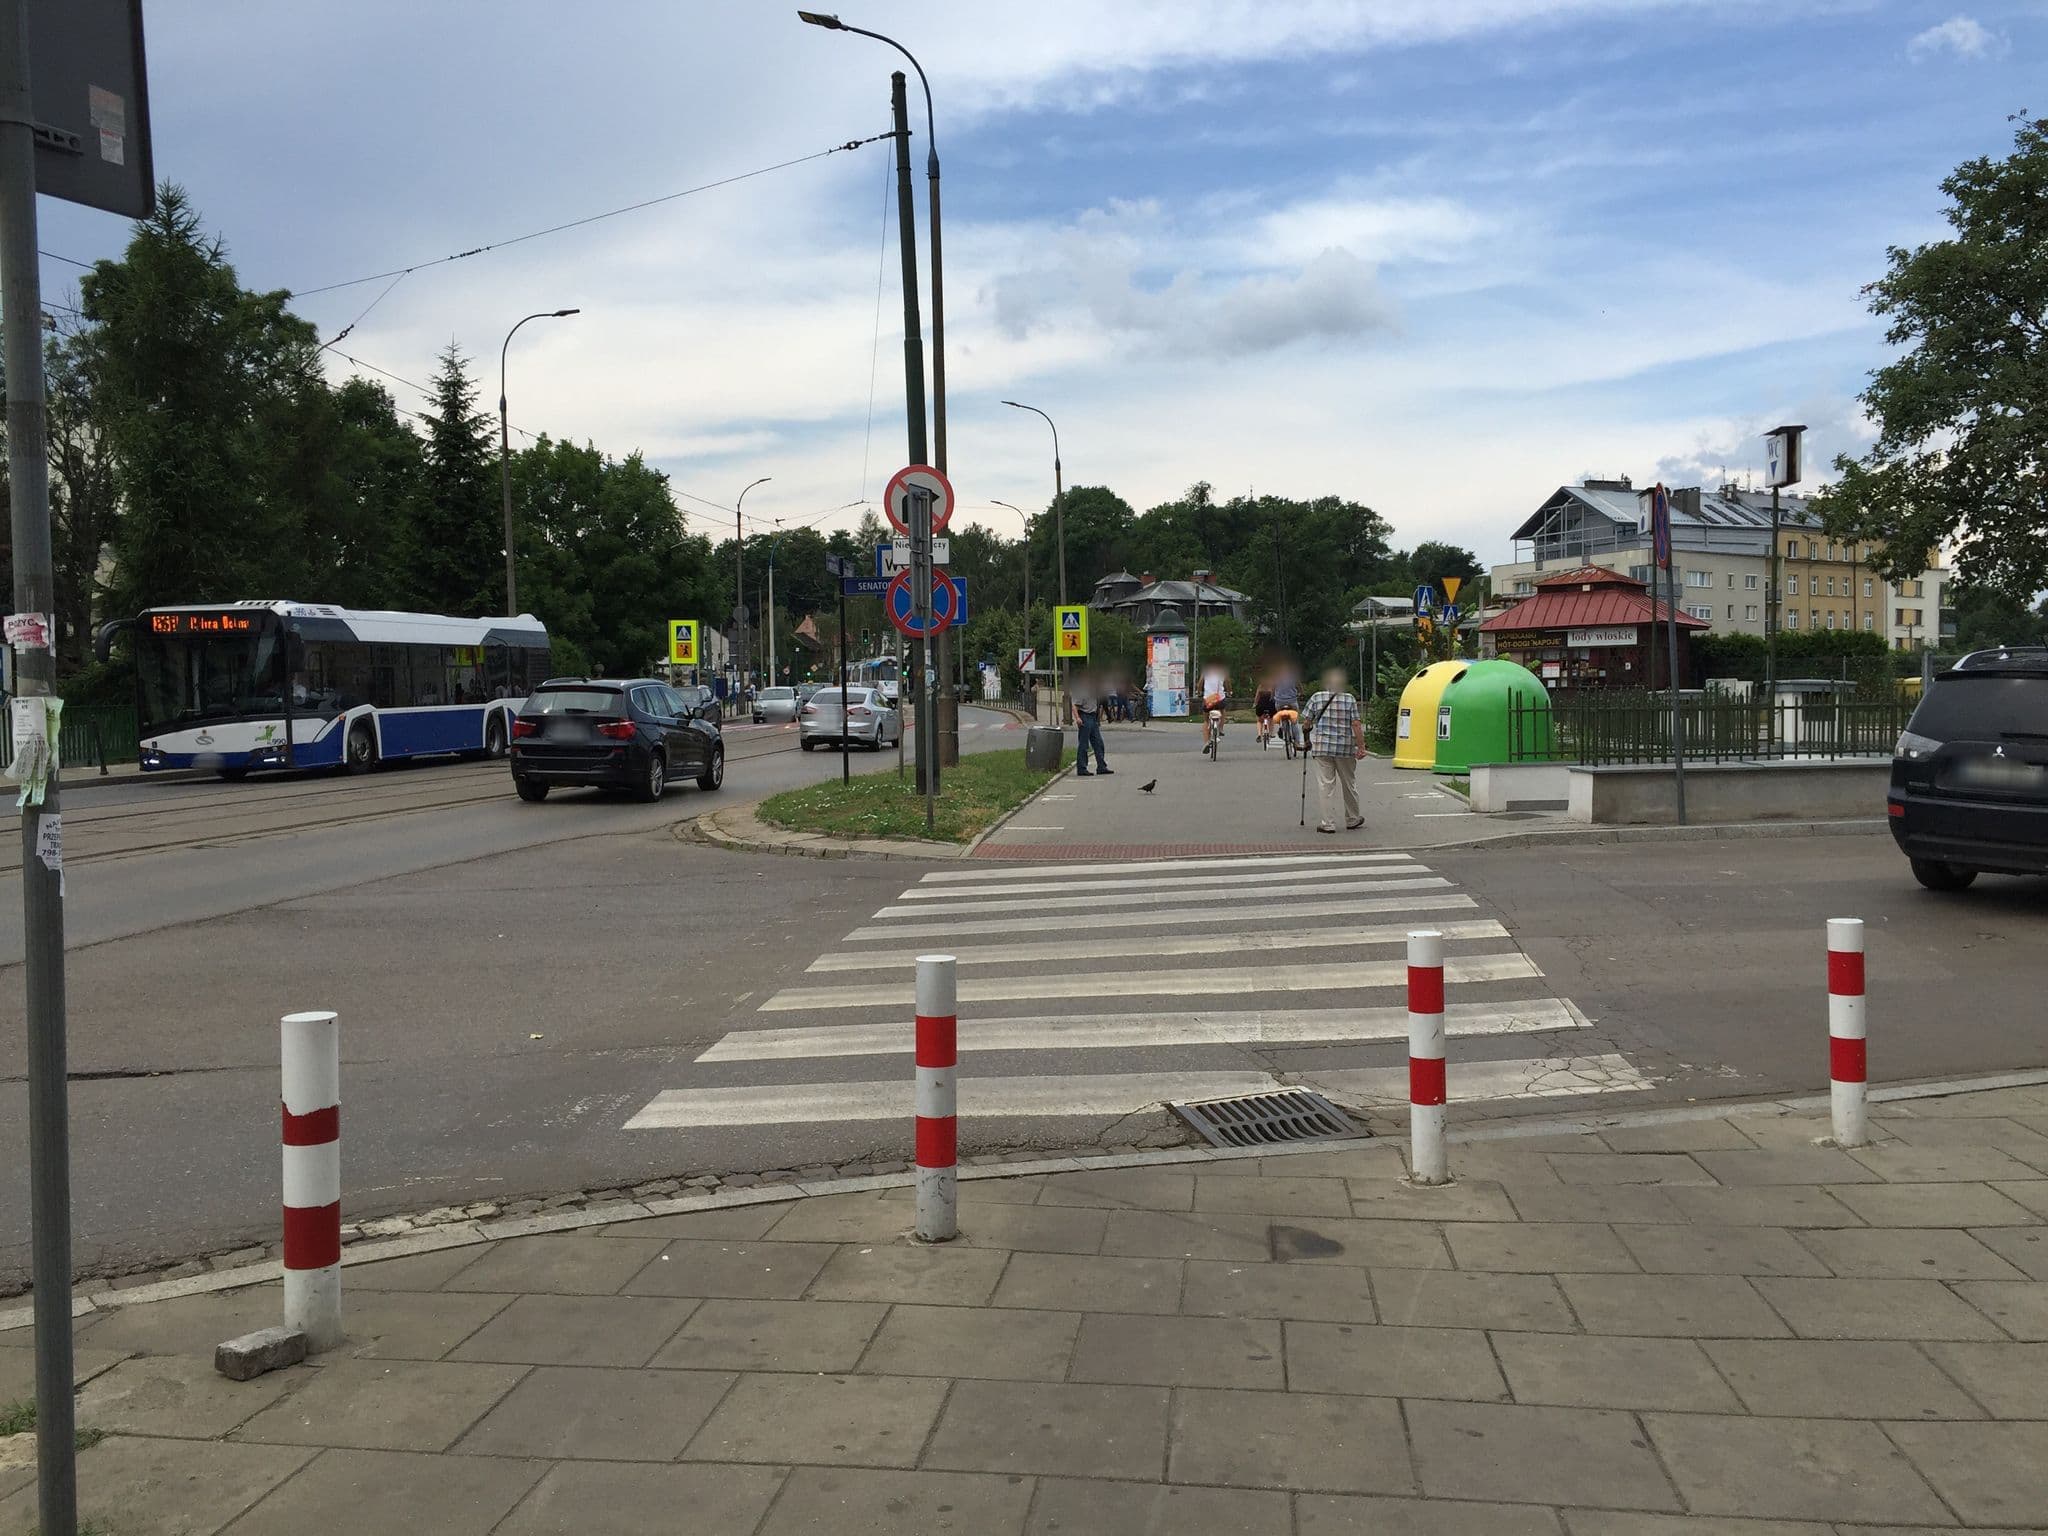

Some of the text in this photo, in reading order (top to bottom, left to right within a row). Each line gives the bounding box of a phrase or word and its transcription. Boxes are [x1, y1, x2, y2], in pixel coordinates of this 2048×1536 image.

[1768, 440, 1781, 458] WC
[858, 581, 890, 592] SENATO
[1571, 630, 1593, 644] lody
